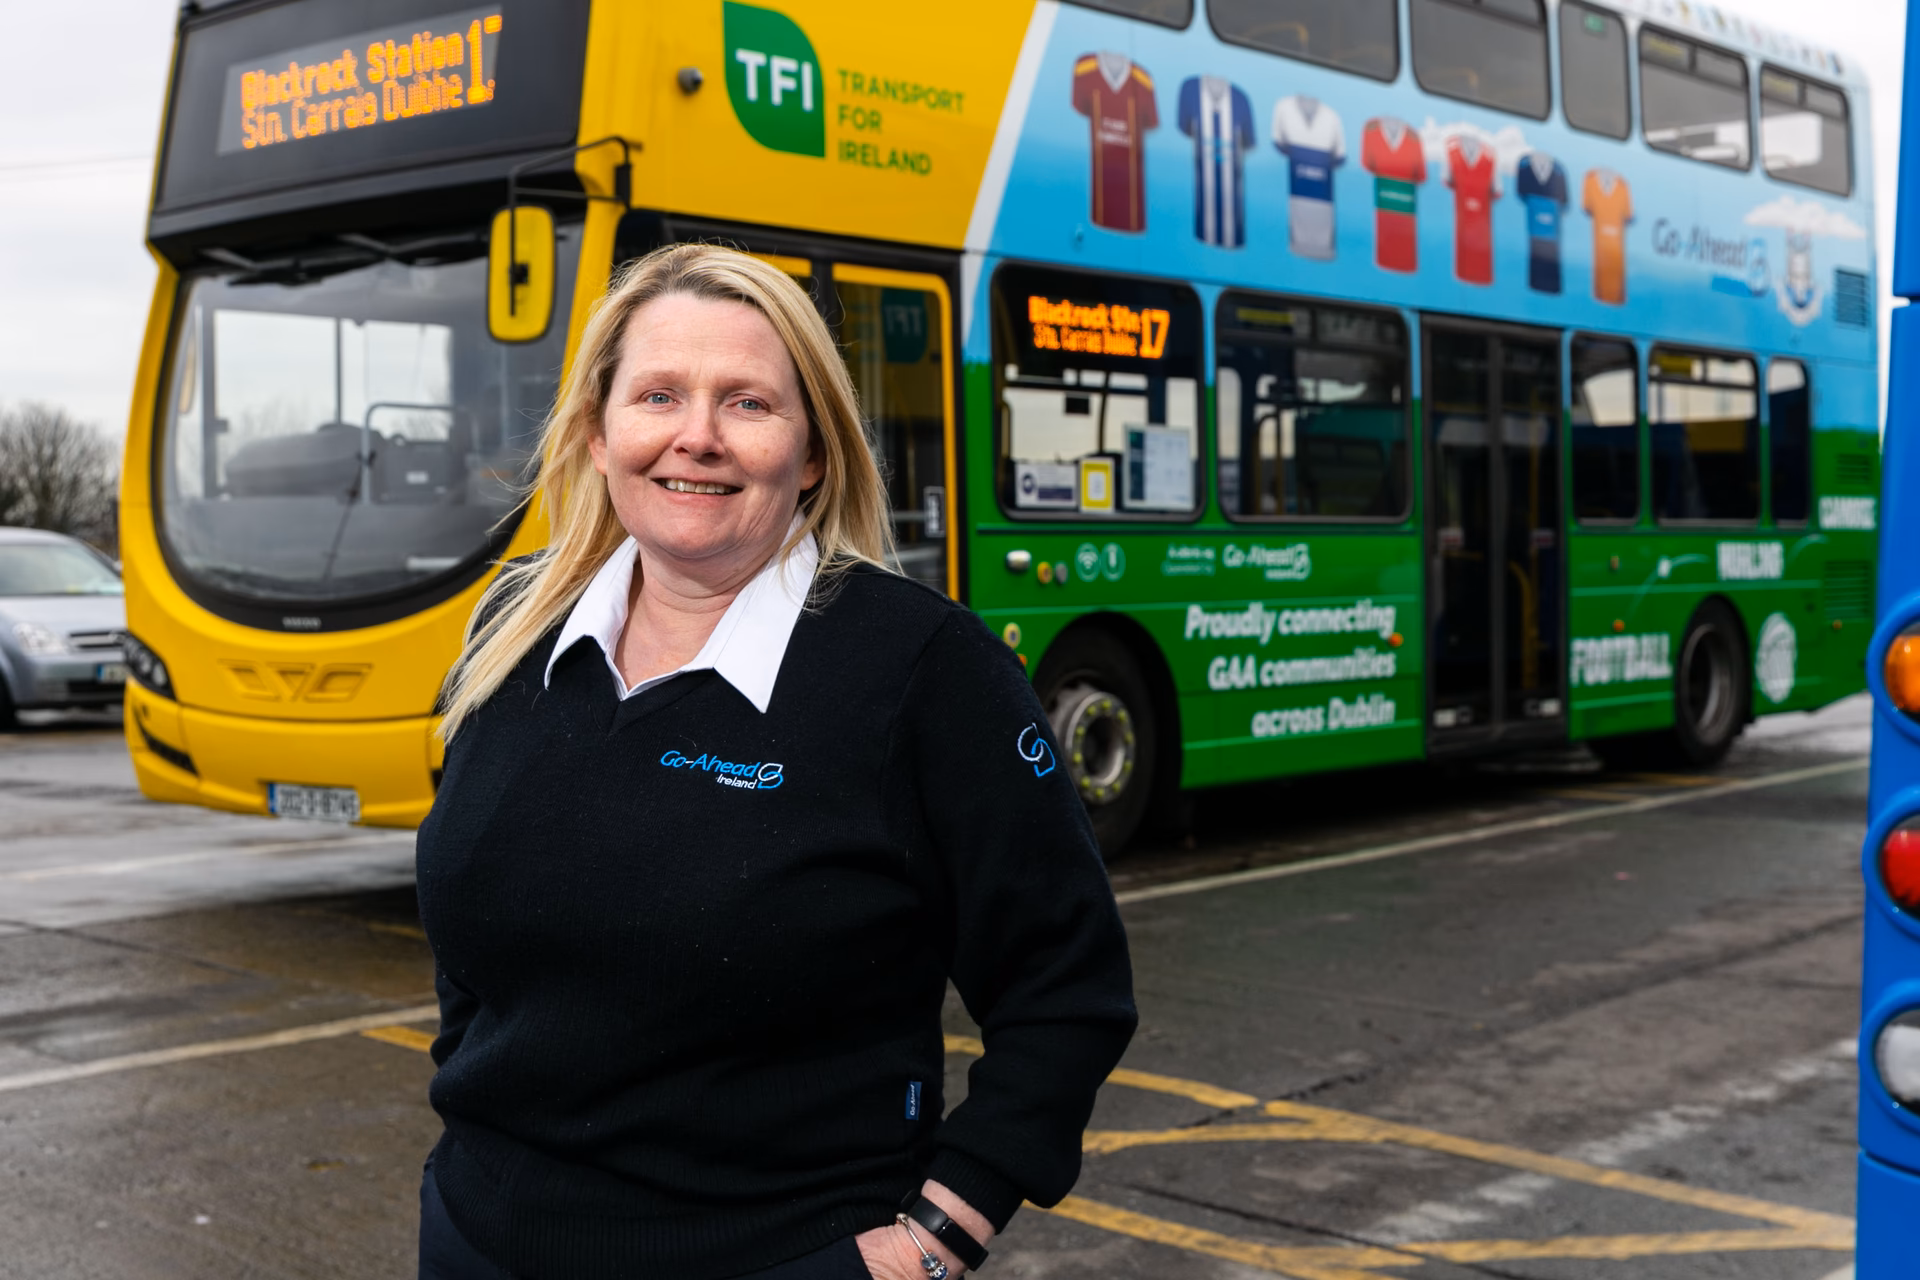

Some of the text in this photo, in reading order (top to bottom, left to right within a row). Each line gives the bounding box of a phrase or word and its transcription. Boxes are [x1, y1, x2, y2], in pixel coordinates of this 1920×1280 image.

[241, 30, 464, 112] Blackrock Station
[735, 48, 814, 112] TFI
[837, 67, 966, 114] TRANSPORT
[837, 103, 882, 134] FOR
[837, 138, 932, 176] IRELAND
[1139, 308, 1170, 359] 17
[1184, 598, 1396, 645] Proudly connecting
[1207, 645, 1396, 690] GAA communities
[1570, 633, 1672, 687] FOOTBALL
[1252, 693, 1396, 738] across Dublin
[660, 750, 761, 778] Go-Ahead
[717, 774, 757, 789] Ireland
